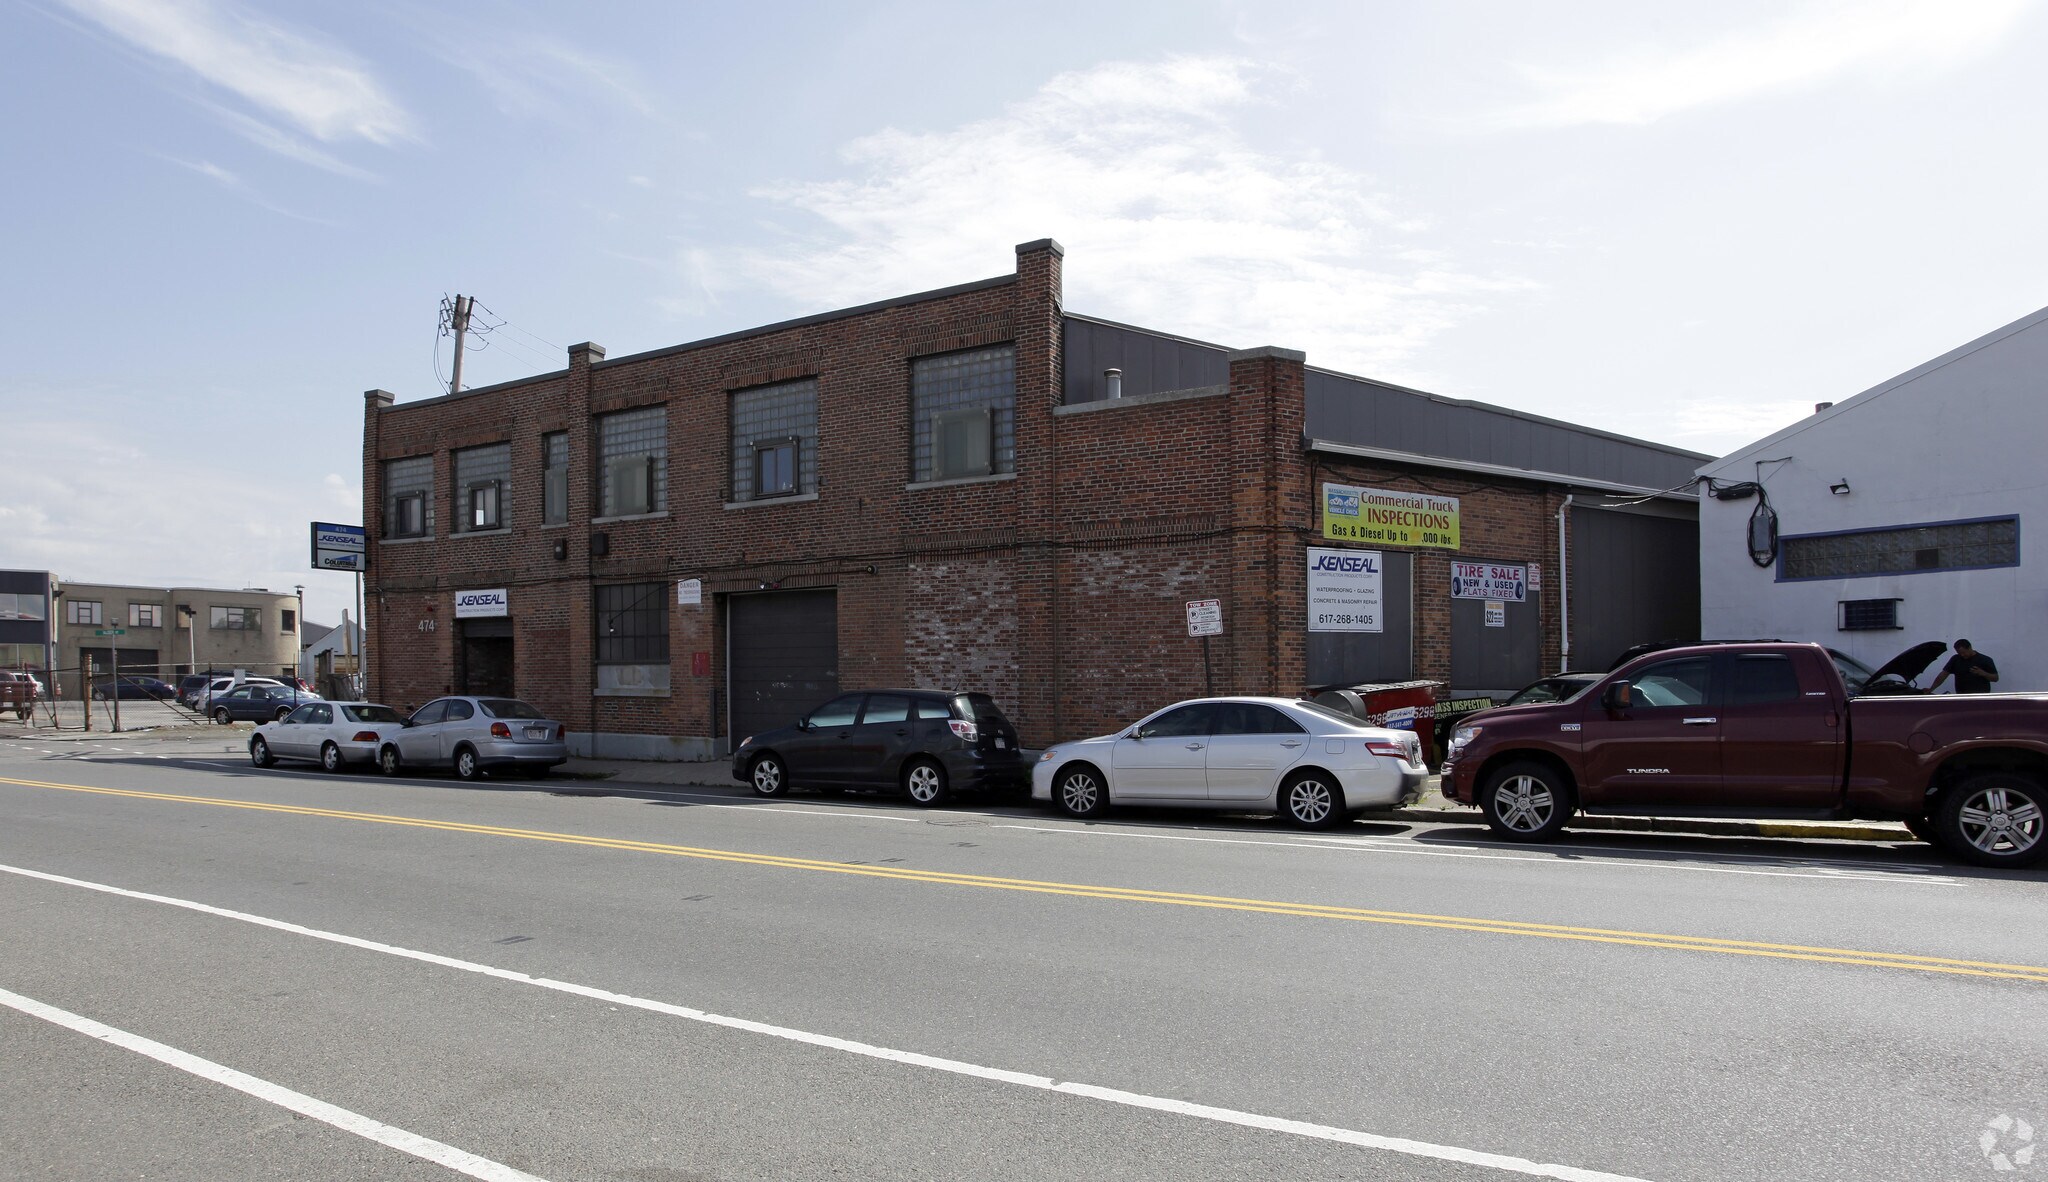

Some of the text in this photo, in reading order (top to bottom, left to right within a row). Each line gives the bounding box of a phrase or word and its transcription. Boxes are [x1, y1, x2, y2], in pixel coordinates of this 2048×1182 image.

[1361, 491, 1454, 512] Commercial Truck
[1368, 508, 1449, 530] INSPECTIONS
[318, 535, 363, 545] KENSEAL
[1332, 523, 1347, 536] Gas
[1351, 525, 1356, 537] &
[1360, 526, 1384, 540] Diesel
[1387, 529, 1397, 542] Up
[1400, 530, 1408, 541] to
[1440, 534, 1453, 544] lbs.
[1311, 556, 1378, 573] KENSEAL
[1457, 564, 1484, 578] TIRE
[1491, 567, 1520, 580] SALE
[1463, 579, 1514, 589] NEW & USED
[1463, 587, 1514, 598] FLATS FIXED
[457, 594, 505, 606] KENSEAL
[1319, 614, 1373, 624] 617-268-1405
[418, 620, 434, 632] 474
[1452, 698, 1491, 711] INSPECTION
[1413, 705, 1435, 719] 5298
